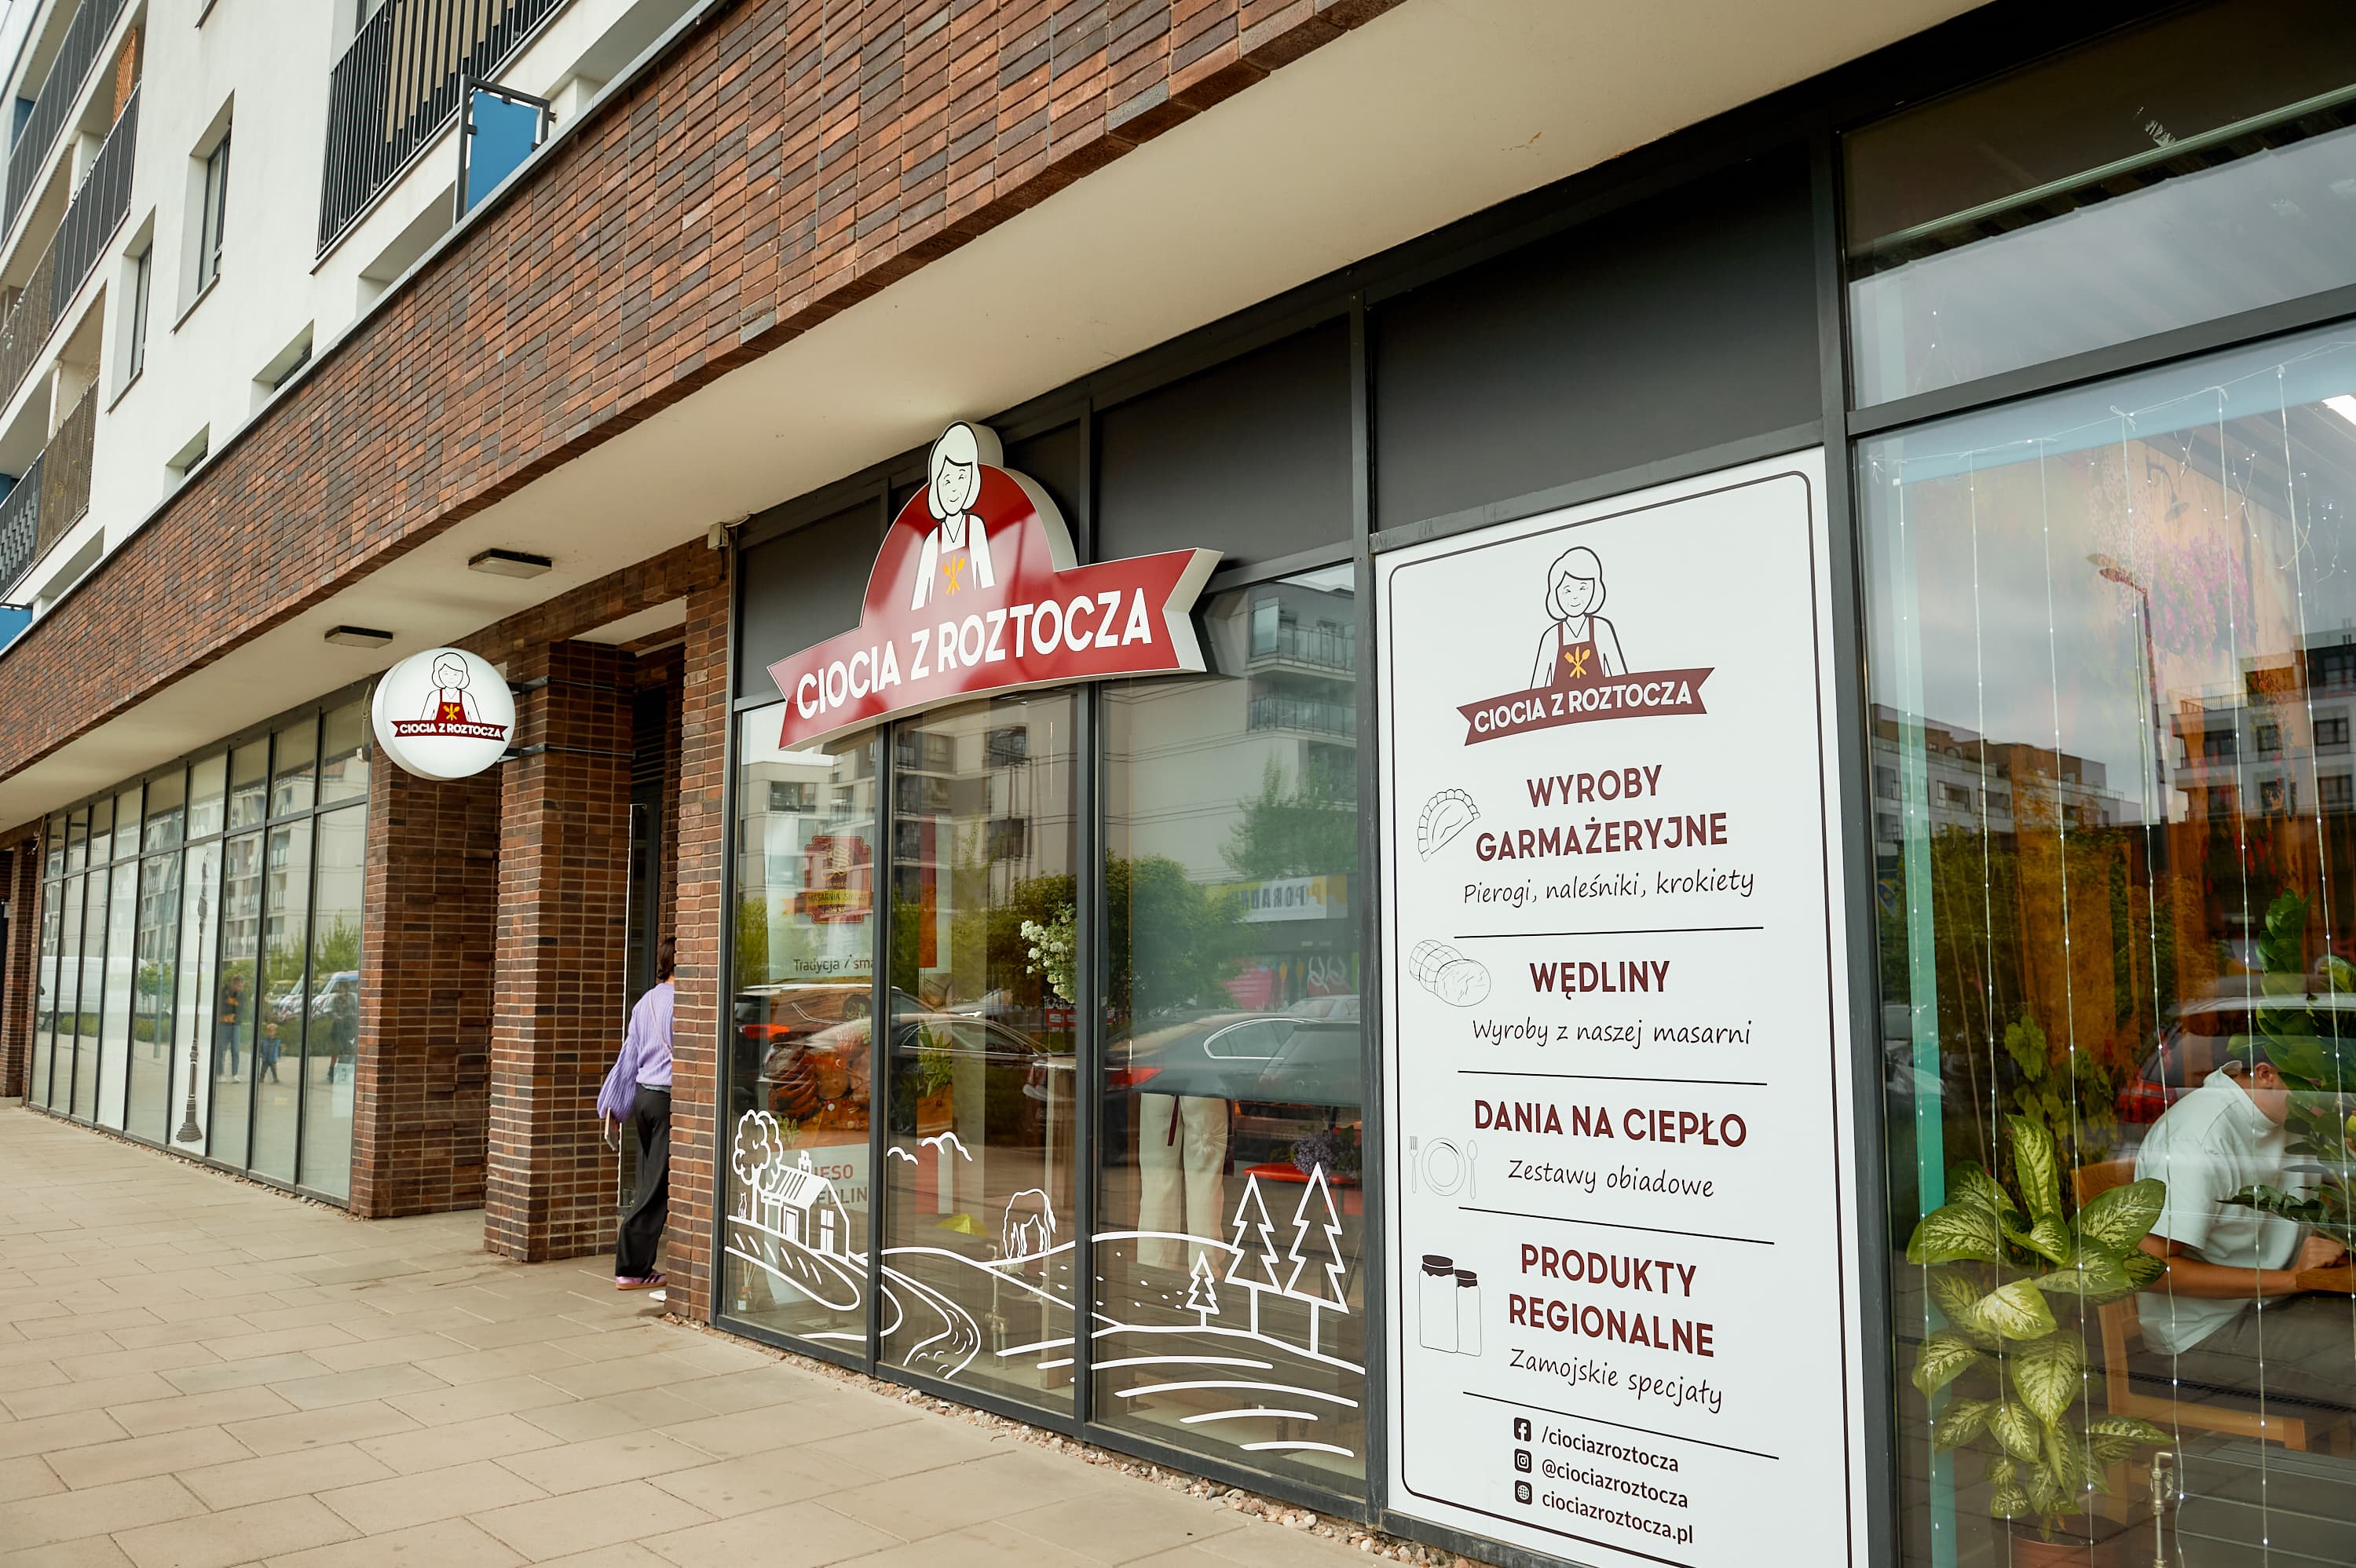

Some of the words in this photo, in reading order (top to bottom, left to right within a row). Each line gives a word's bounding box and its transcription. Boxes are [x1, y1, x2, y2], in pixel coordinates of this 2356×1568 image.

[796, 640, 902, 719] CIOCIA
[910, 628, 930, 681] Z
[937, 587, 1152, 673] ROZTOCZA
[400, 723, 437, 733] CIOCIA
[438, 723, 445, 733] Z
[446, 724, 501, 737] ROZTOCZA
[1474, 697, 1547, 733] CIOCIA
[1551, 693, 1565, 717] Z
[1568, 681, 1692, 714] ROZTOCZA
[1527, 764, 1663, 808] WYROBY
[1476, 812, 1728, 862] GARMAŻERYJNE
[807, 893, 840, 902] MASARNIA
[1464, 879, 1537, 908] Pierogi,
[1546, 872, 1646, 901] naleśniki,
[1656, 868, 1754, 897] krokiety
[793, 958, 840, 974] Tradycja
[1529, 960, 1670, 1000] WĘDLINY
[1472, 1016, 1548, 1047] Wyroby
[1556, 1025, 1569, 1041] z
[1577, 1019, 1642, 1050] naszej
[1654, 1020, 1752, 1045] masarni
[1474, 1099, 1564, 1135] DANIA
[1572, 1105, 1615, 1139] NA
[1622, 1108, 1747, 1148] CIEPŁO
[1508, 1160, 1596, 1194] Zestawy
[1607, 1164, 1714, 1197] obiadowe
[1521, 1243, 1697, 1297] PRODUKTY
[1509, 1293, 1714, 1358] REGIONALNE
[1509, 1348, 1619, 1387] Zamojskie
[1627, 1373, 1722, 1414] specjały
[1541, 1425, 1679, 1473] /ciociazroztocza
[1542, 1459, 1688, 1509] @ciociazroztocza
[1542, 1490, 1693, 1544] ciociazroztocza.pl
